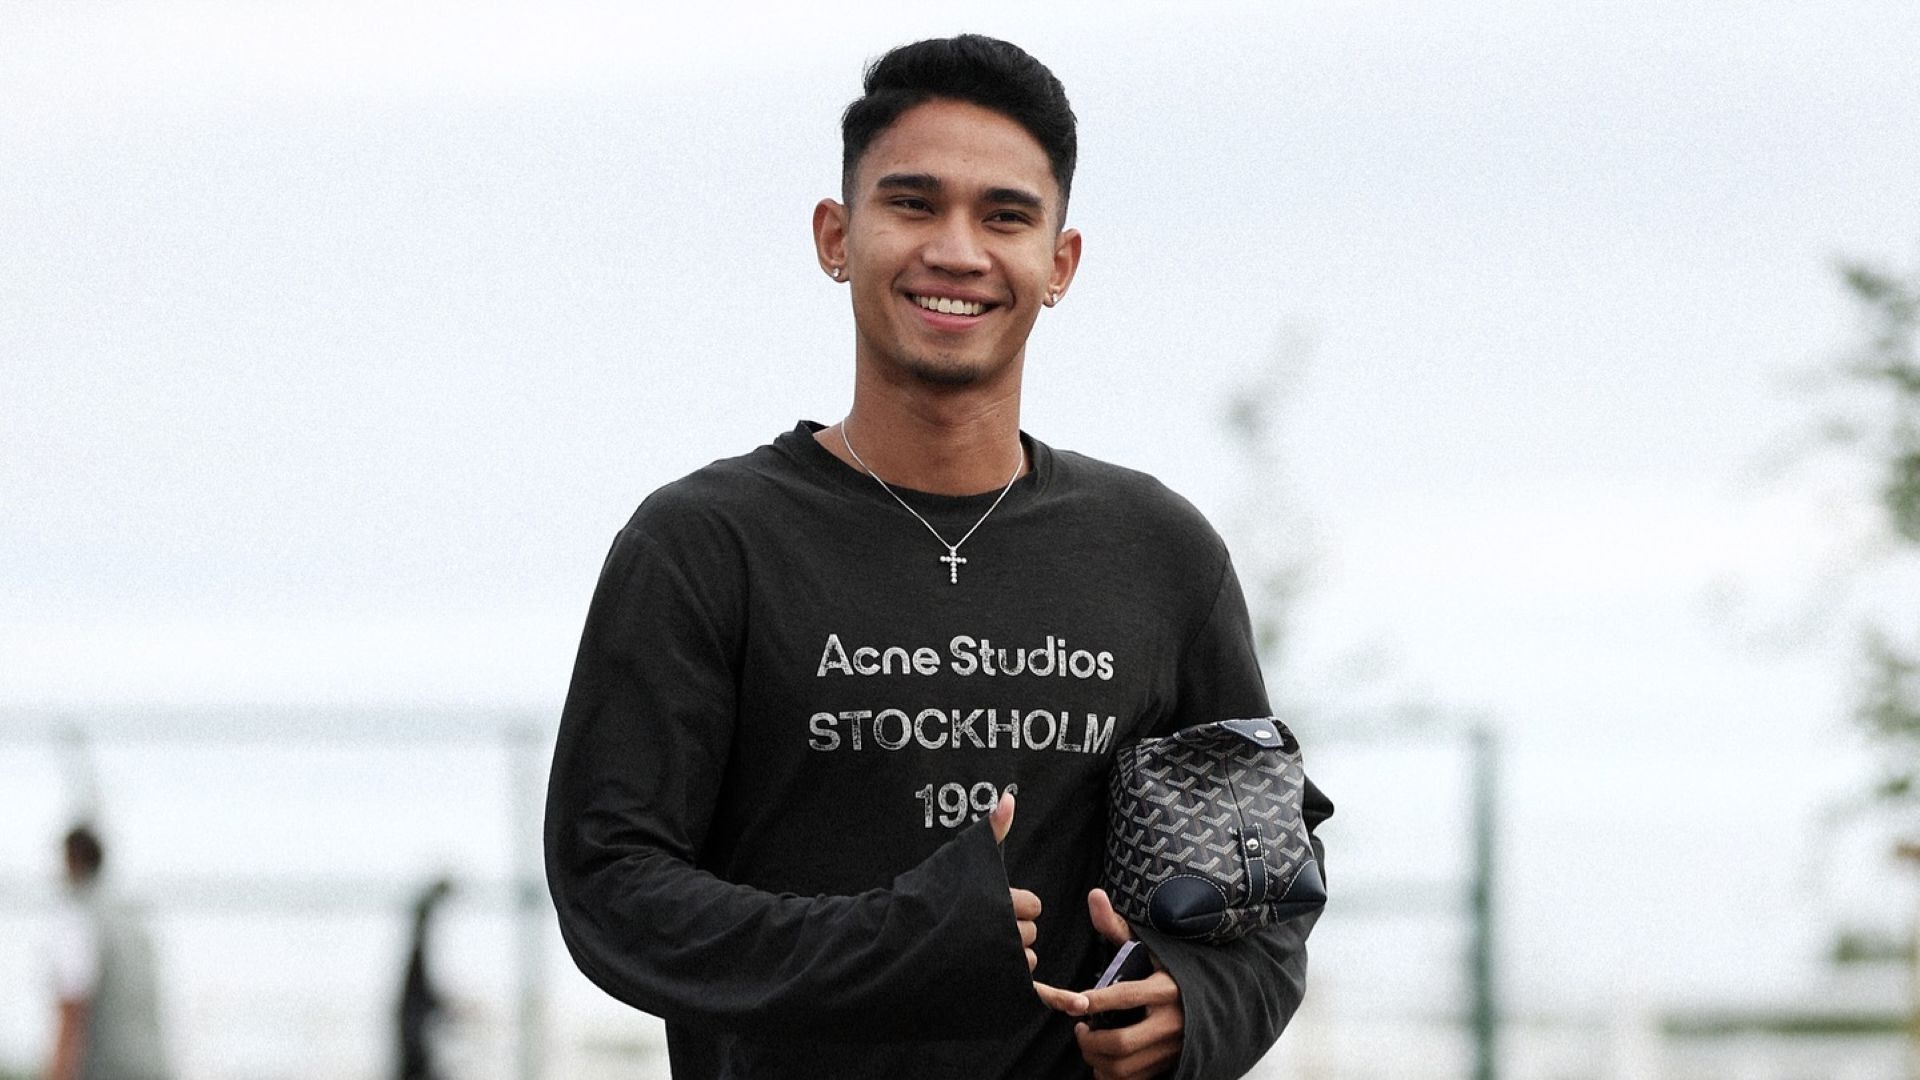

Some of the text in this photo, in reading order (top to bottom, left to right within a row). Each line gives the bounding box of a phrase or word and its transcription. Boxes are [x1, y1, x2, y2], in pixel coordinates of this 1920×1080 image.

[816, 633, 1115, 681] Acne Studios
[808, 708, 1117, 754] STOCKHOLM
[915, 781, 1019, 829] 199
